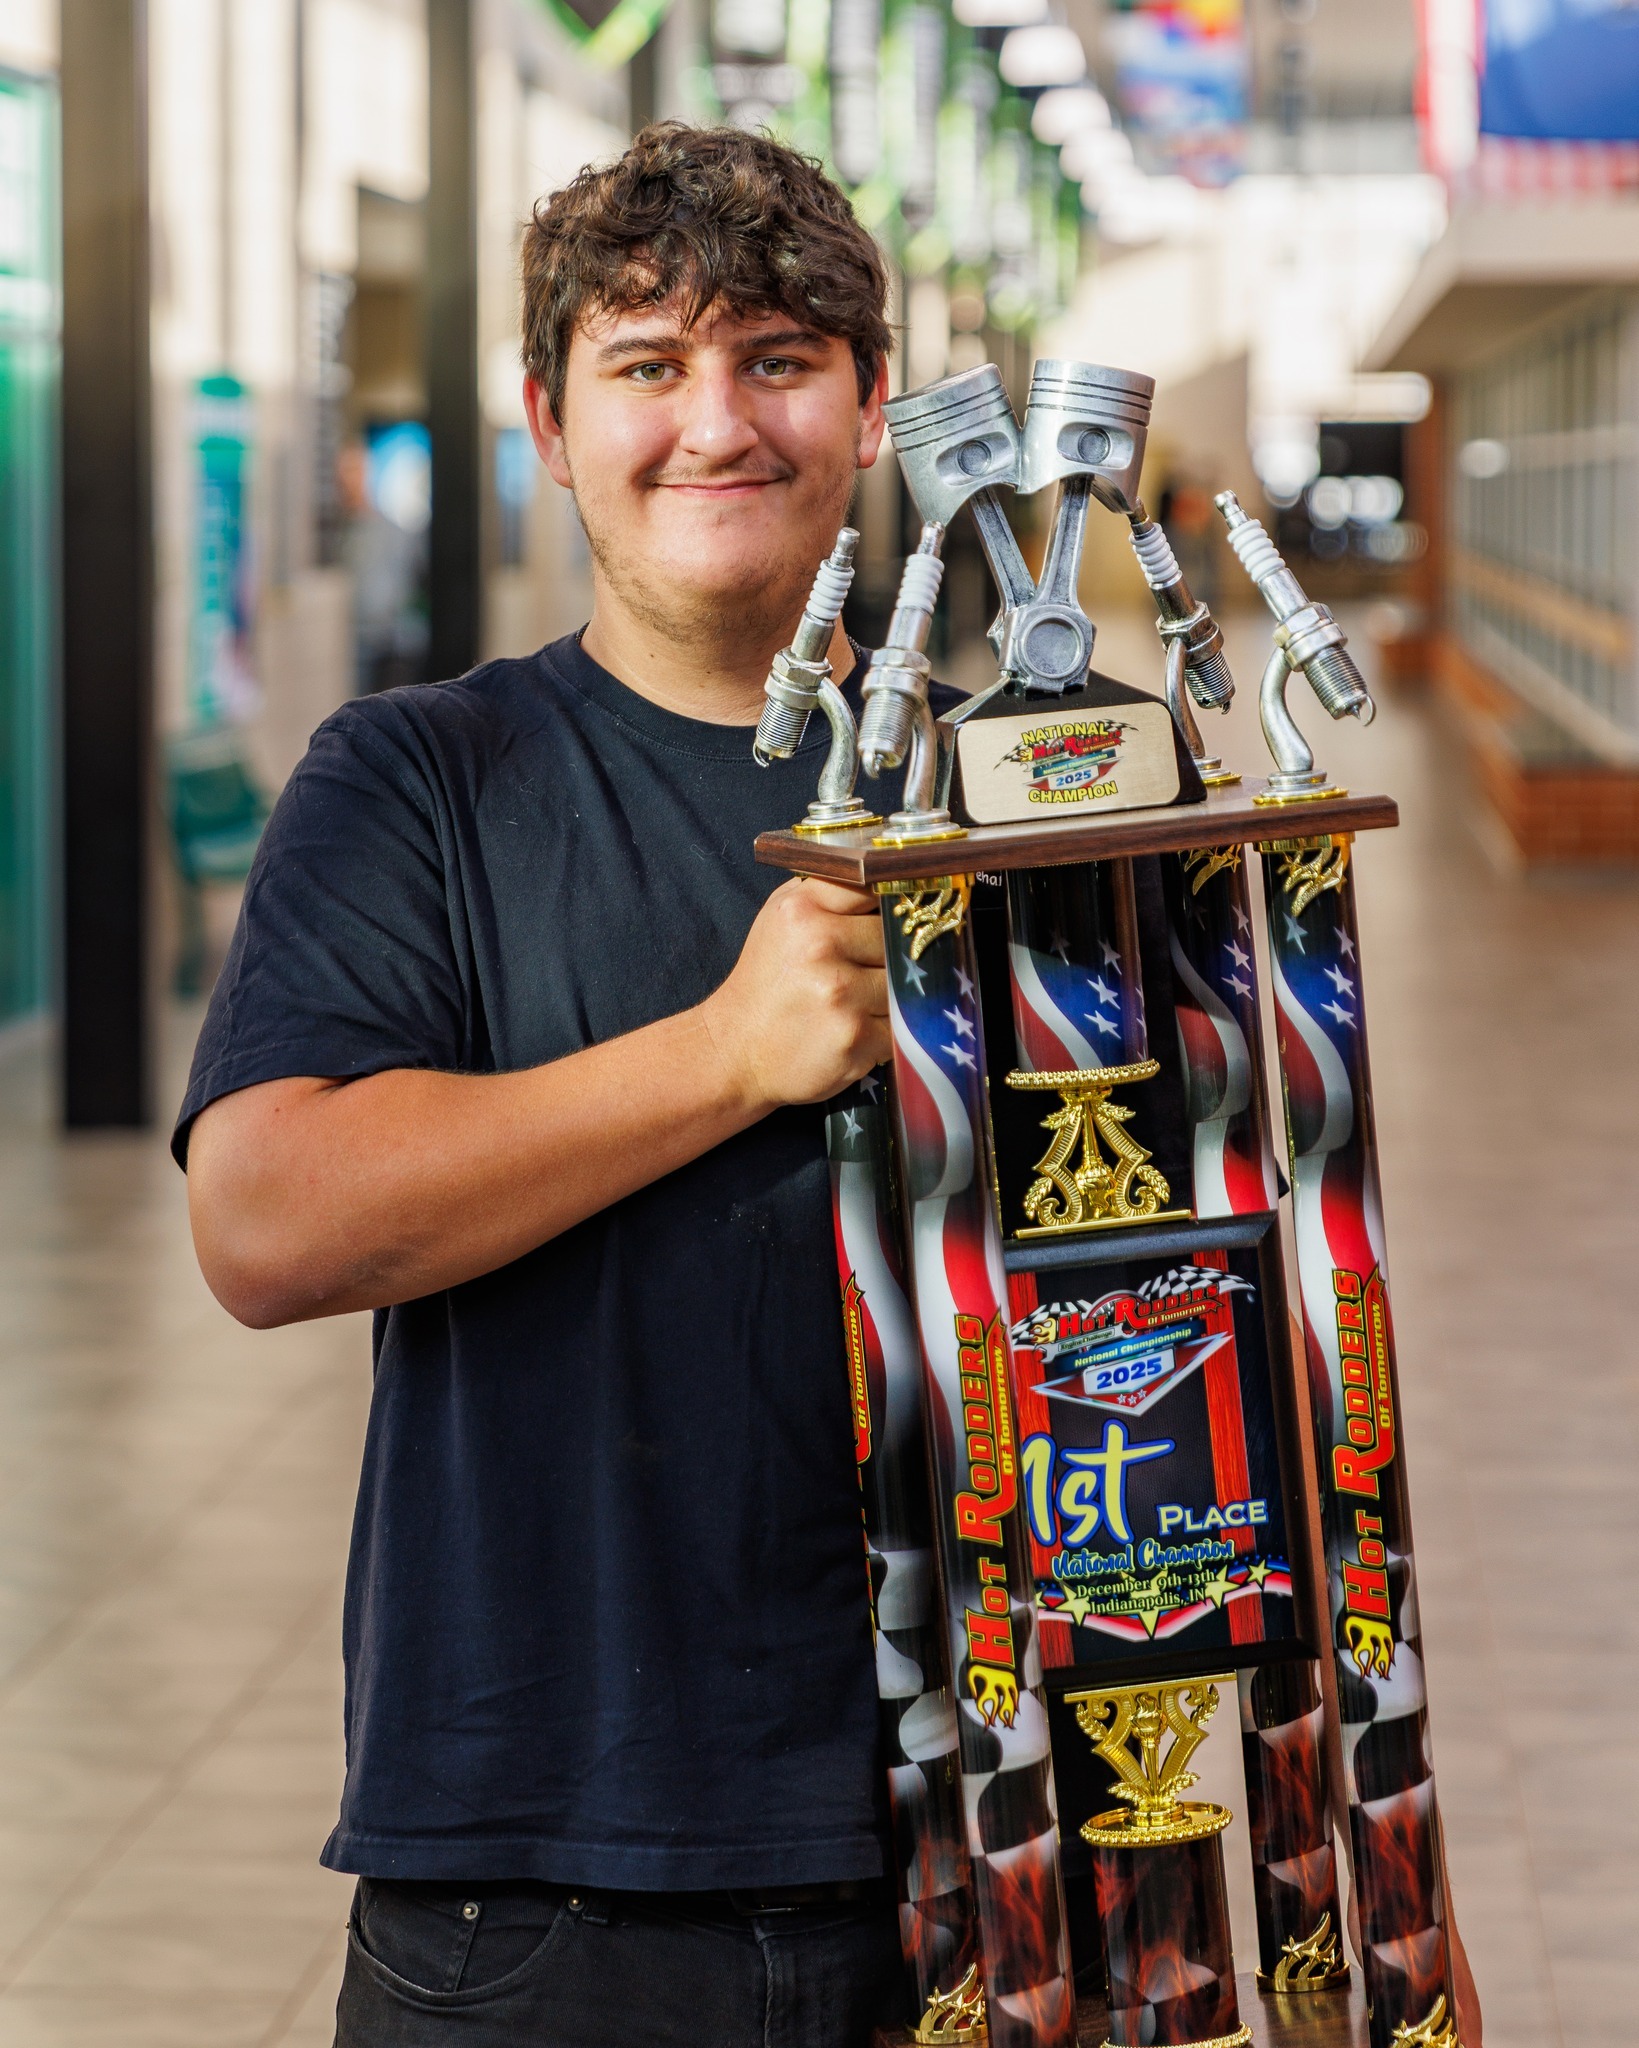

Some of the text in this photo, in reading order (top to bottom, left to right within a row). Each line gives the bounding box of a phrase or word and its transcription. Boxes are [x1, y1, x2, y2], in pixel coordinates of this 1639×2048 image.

[1021, 722, 1109, 744] NATIONAL
[1029, 780, 1118, 803] CHAMPION
[1056, 769, 1092, 787] 2025
[1058, 1284, 1220, 1339] HOT RODDERS
[1147, 1304, 1207, 1326] Of Tomorrow
[1074, 1327, 1192, 1367] National Championship
[1370, 1301, 1390, 1428] Of Tomorrow
[849, 1308, 867, 1429] Of Tomorrow
[1096, 1356, 1162, 1390] 2025
[993, 1345, 1013, 1475] Of Tomorrow
[1332, 1268, 1395, 1620] HOT RODDERS
[954, 1314, 1017, 1669] HOT RODDERS
[1022, 1420, 1174, 1546] 1st
[1157, 1500, 1268, 1535] PLACE
[1052, 1538, 1235, 1579] National Champion
[1077, 1569, 1215, 1599] December 9th-13th
[1091, 1587, 1206, 1614] Indianapolis, IN
